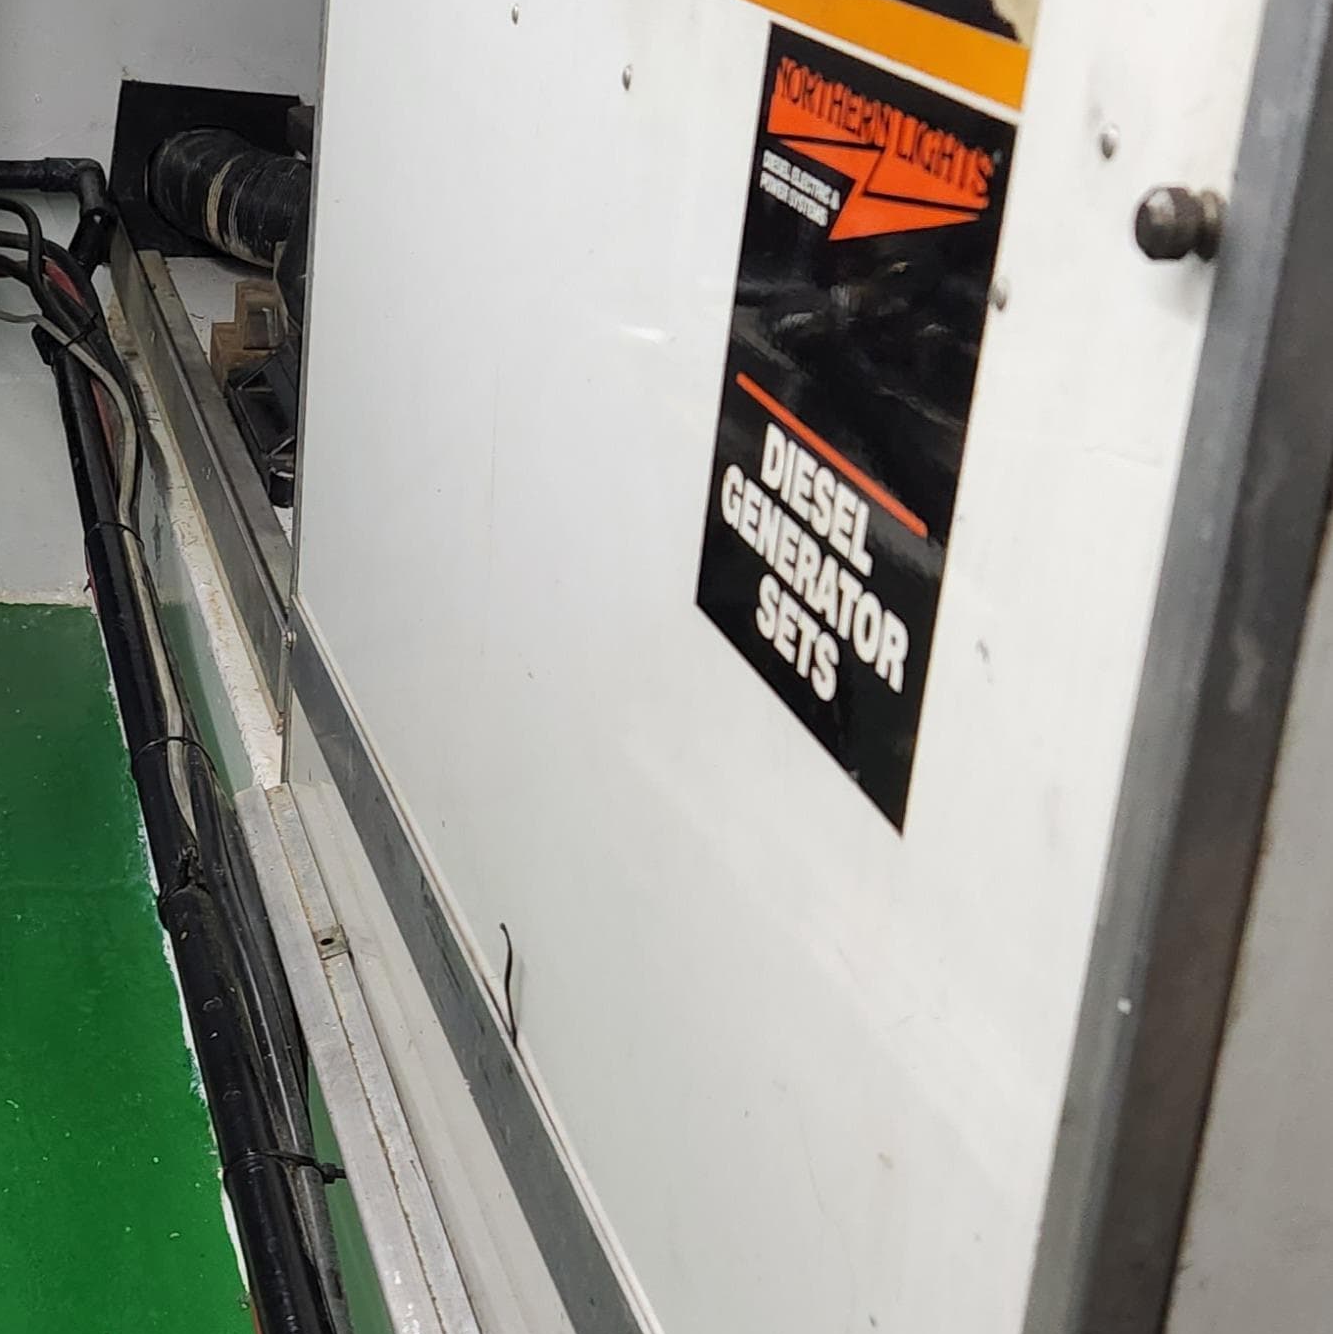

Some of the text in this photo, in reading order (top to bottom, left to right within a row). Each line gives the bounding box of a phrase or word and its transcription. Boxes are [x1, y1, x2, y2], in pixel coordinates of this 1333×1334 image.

[773, 55, 995, 197] NORTHERN LIGHTS
[760, 421, 873, 577] DIESEL
[720, 463, 909, 694] GENERATOR
[755, 573, 840, 704] SETS
